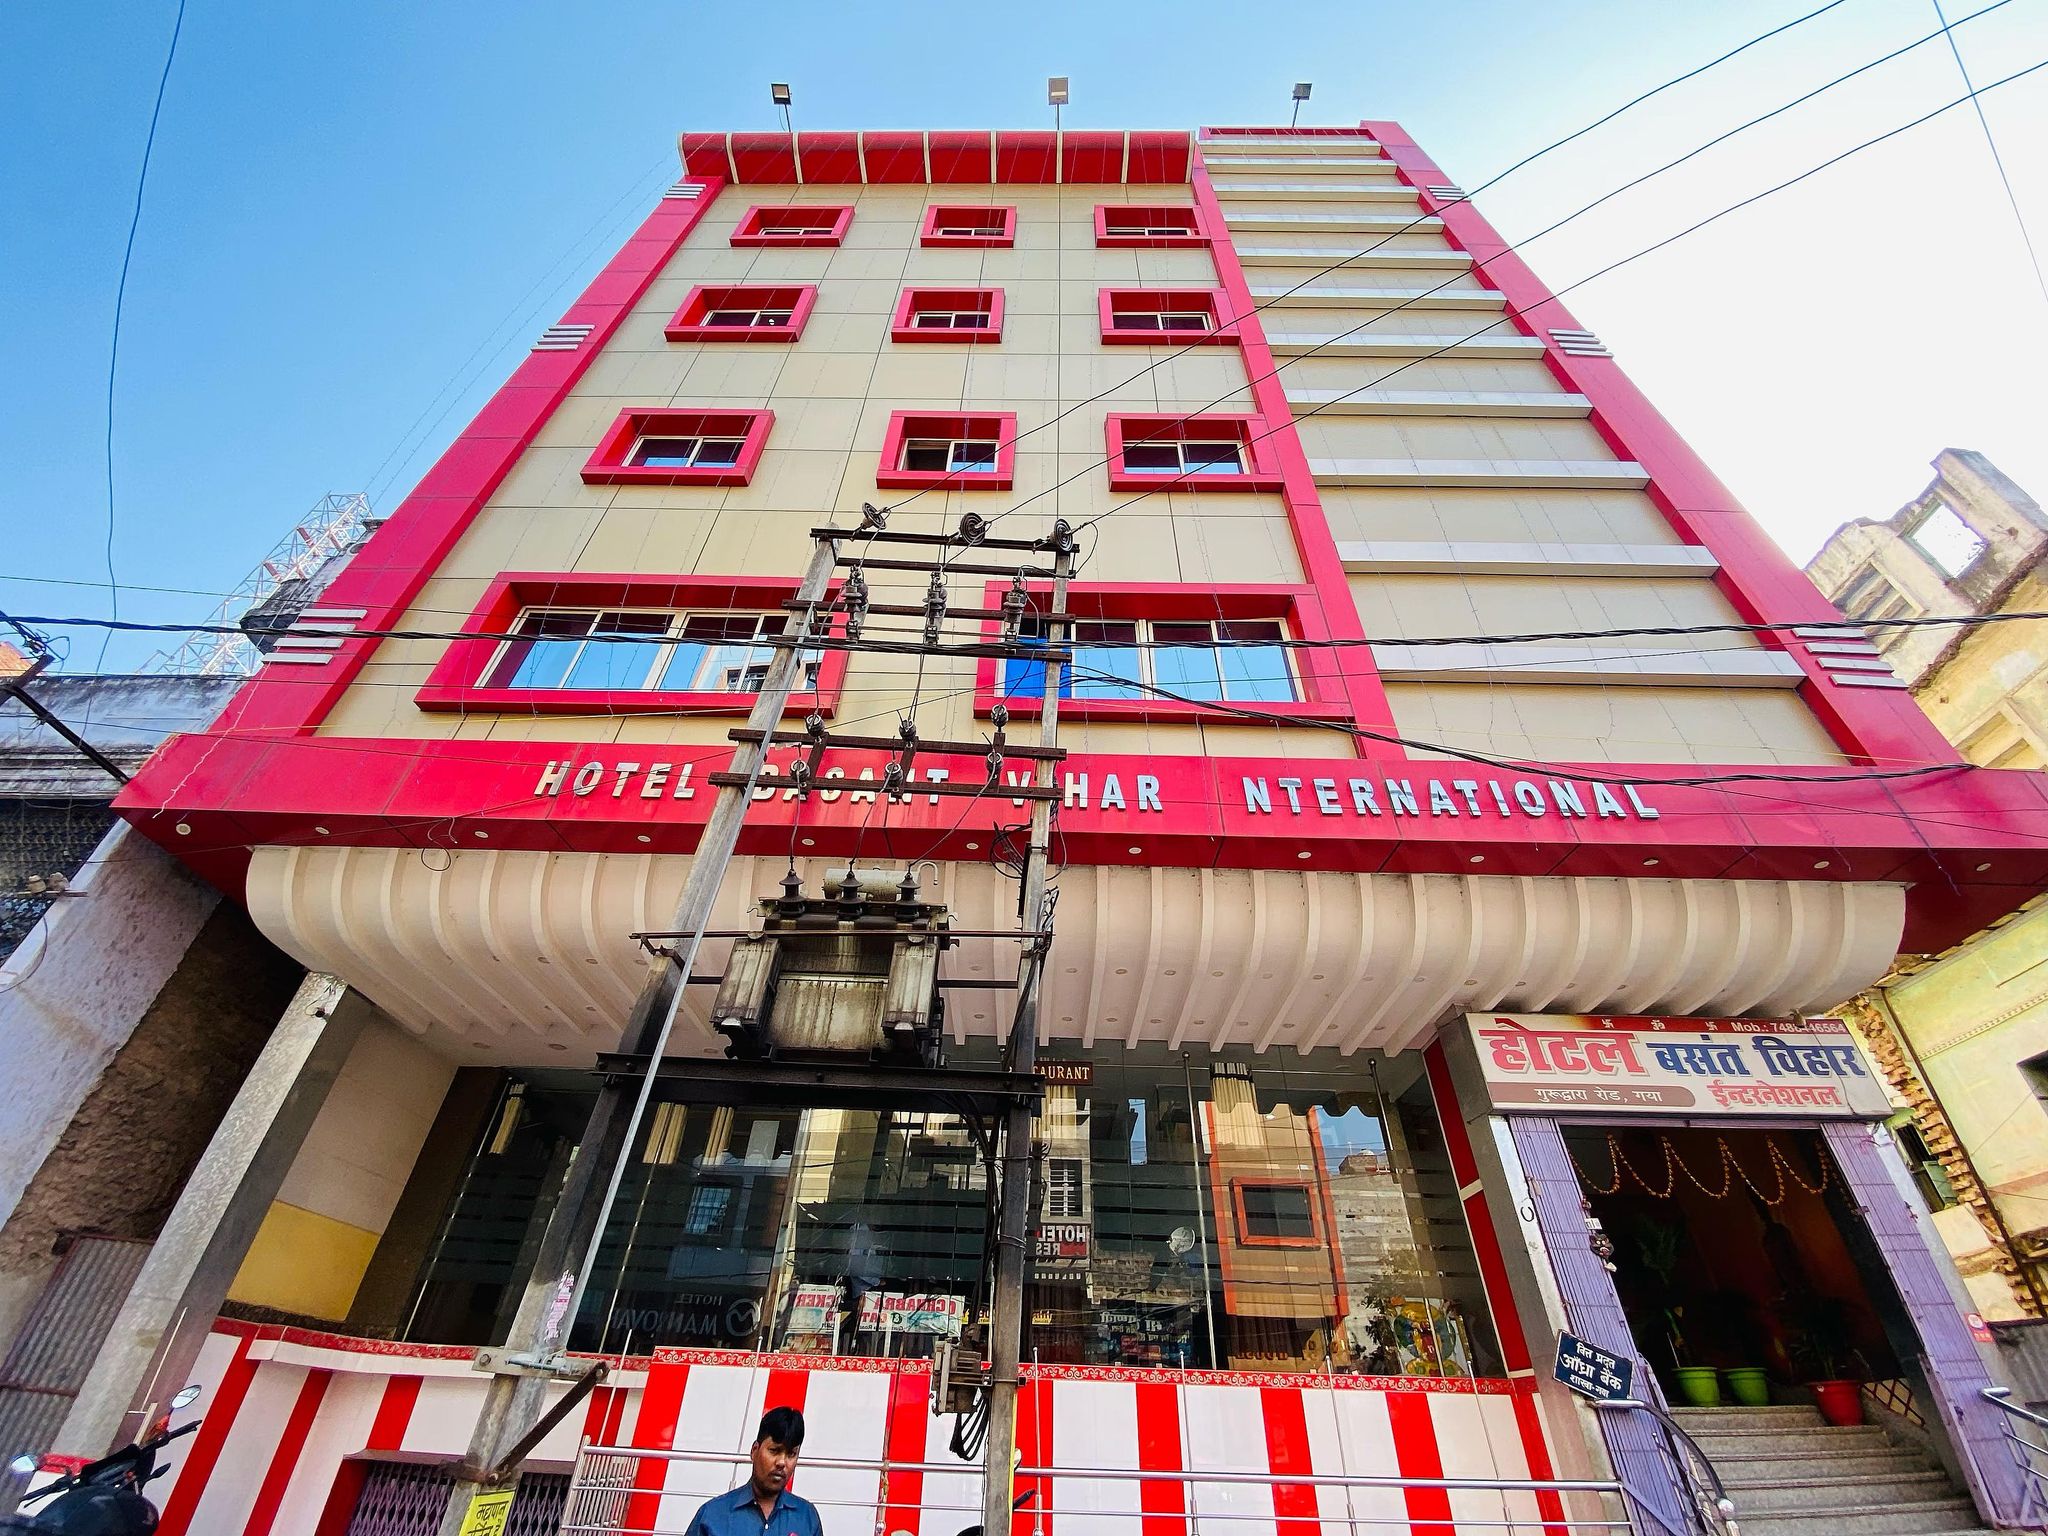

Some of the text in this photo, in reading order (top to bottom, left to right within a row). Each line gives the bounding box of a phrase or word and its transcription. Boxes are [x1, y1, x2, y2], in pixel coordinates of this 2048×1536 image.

[534, 760, 696, 800] HOTEL
[1007, 770, 1164, 812] VHAR
[1242, 776, 1661, 820] NTERNATIONAL
[1731, 1022, 1769, 1033] Mob.:
[1479, 1018, 1866, 1077] होटल बसंत विहार
[1632, 1090, 1663, 1103] गया
[1707, 1079, 1843, 1108] ईन्टरनेशनल
